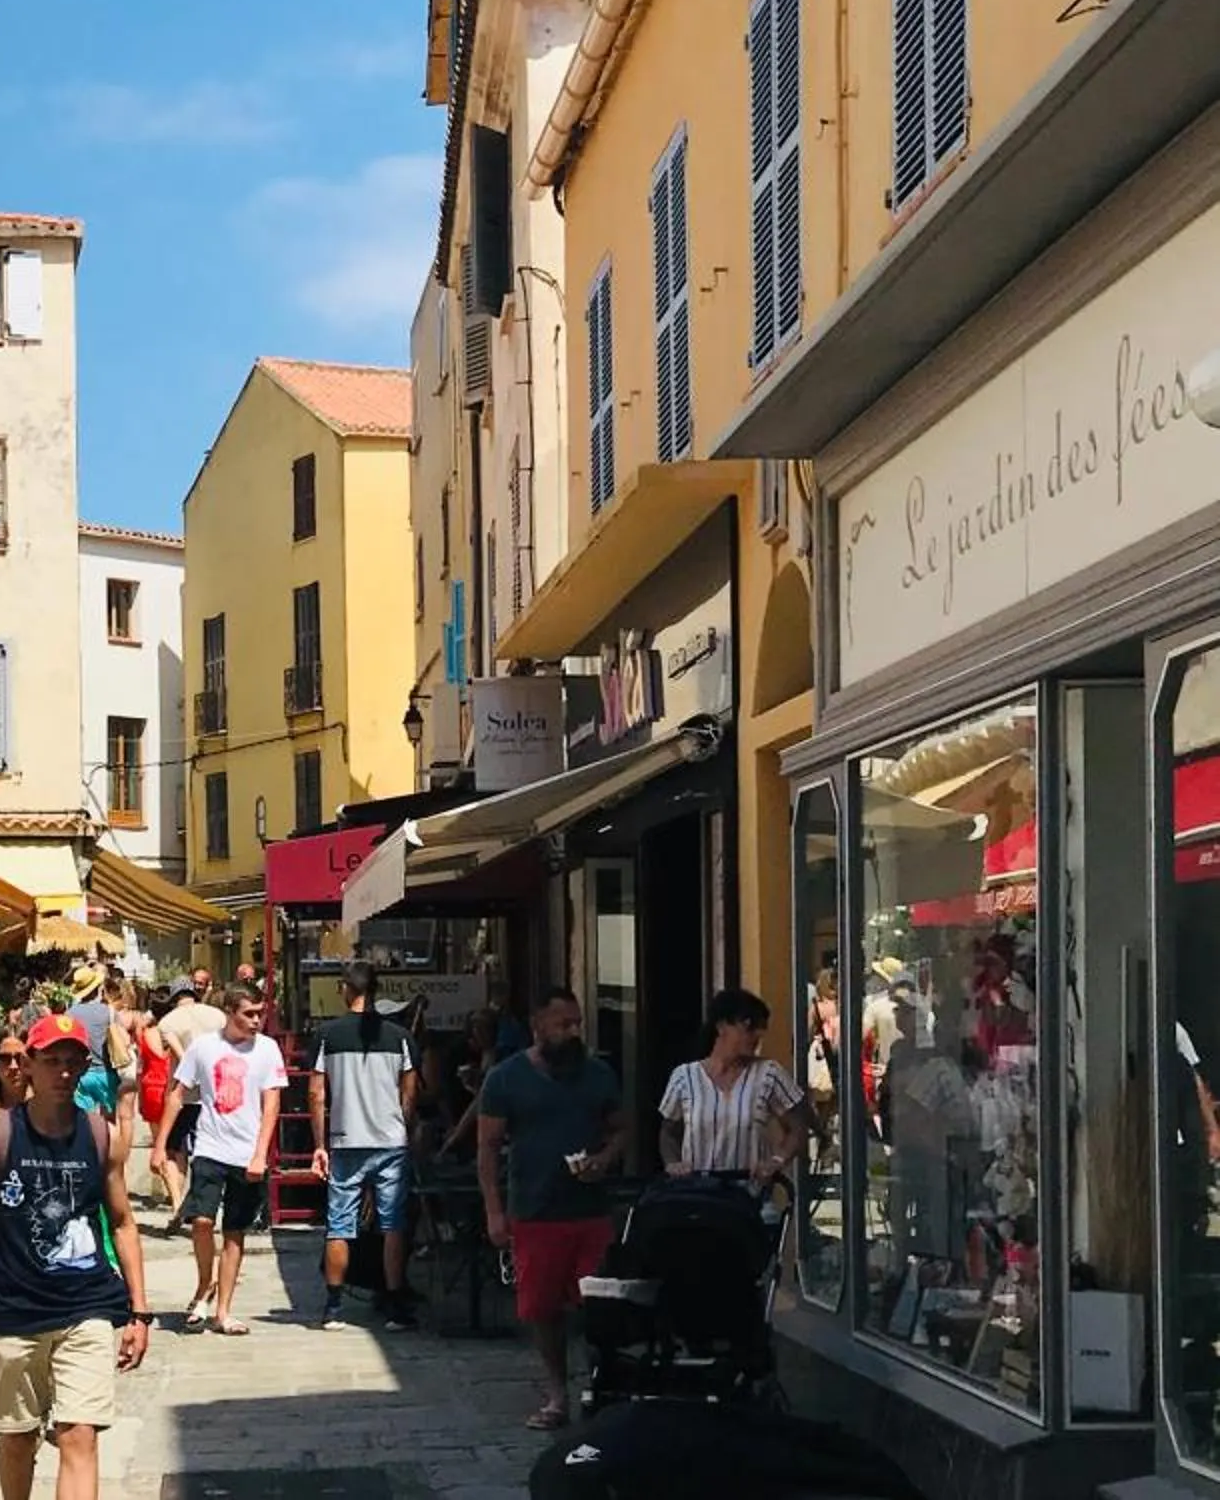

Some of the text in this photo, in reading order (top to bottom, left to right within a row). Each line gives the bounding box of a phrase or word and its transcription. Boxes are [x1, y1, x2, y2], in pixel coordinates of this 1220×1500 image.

[901, 333, 1187, 616] Le jardin des fées
